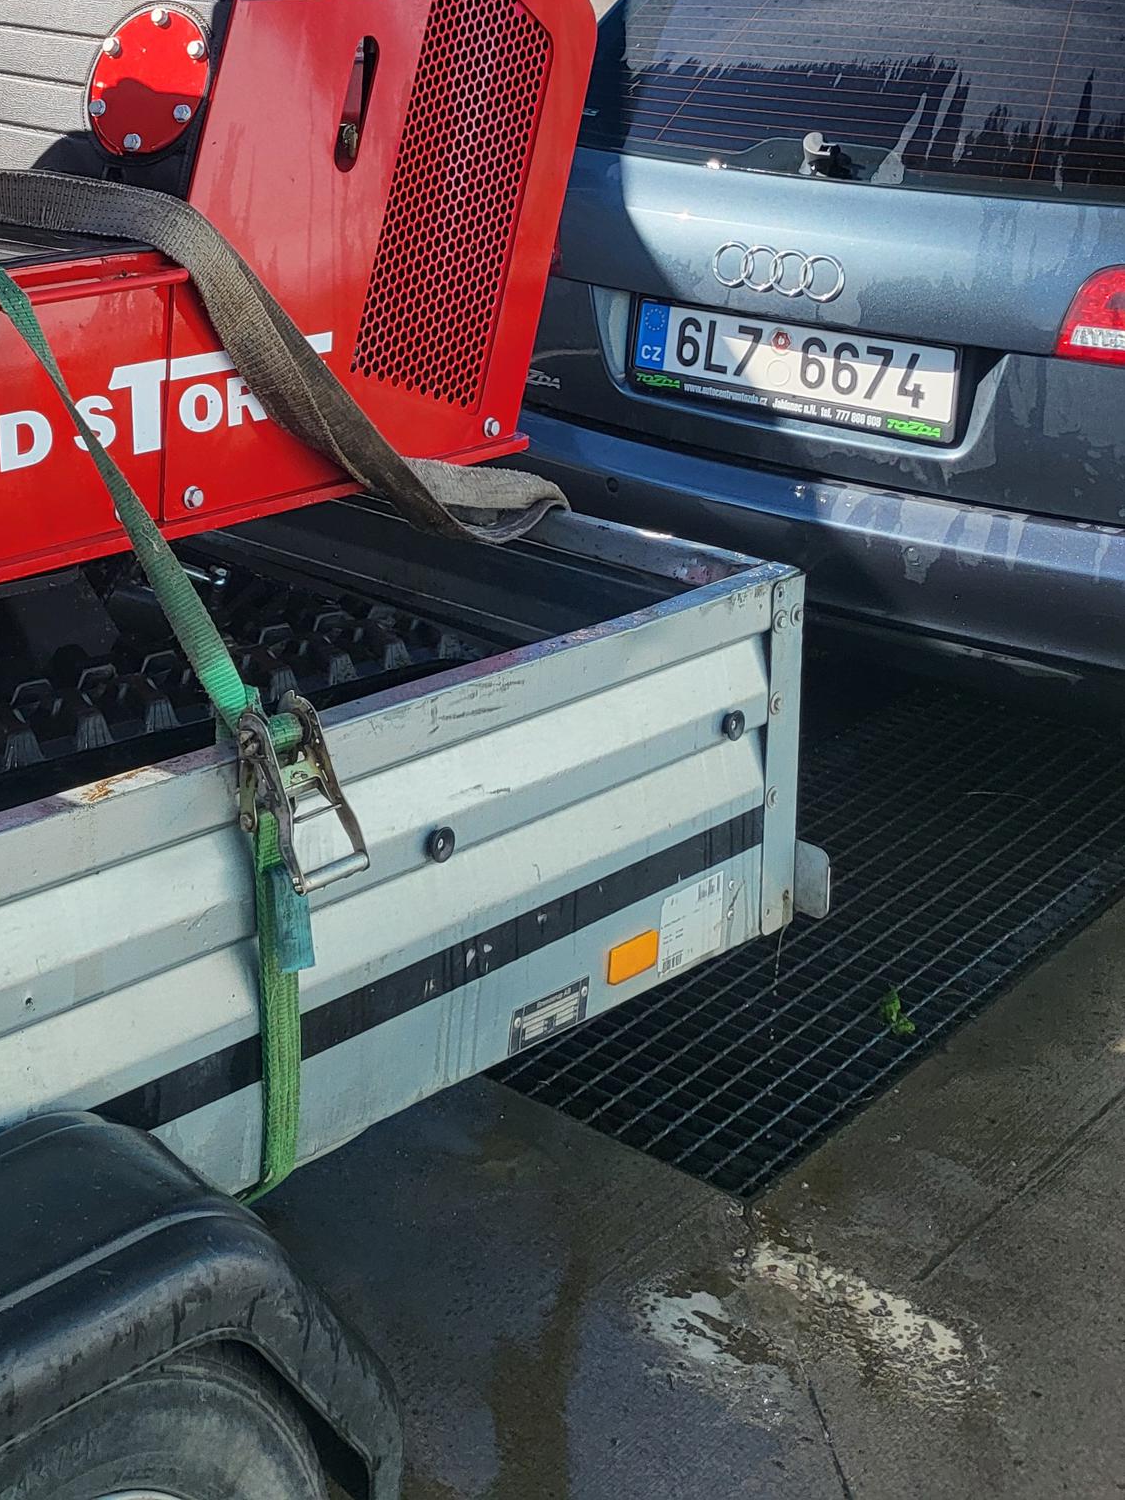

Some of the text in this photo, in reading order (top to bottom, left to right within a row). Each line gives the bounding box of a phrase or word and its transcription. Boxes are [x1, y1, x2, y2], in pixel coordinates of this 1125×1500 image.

[73, 331, 333, 456] STOR
[641, 316, 926, 409] CZ 6L7 6674
[835, 409, 851, 422] 777
